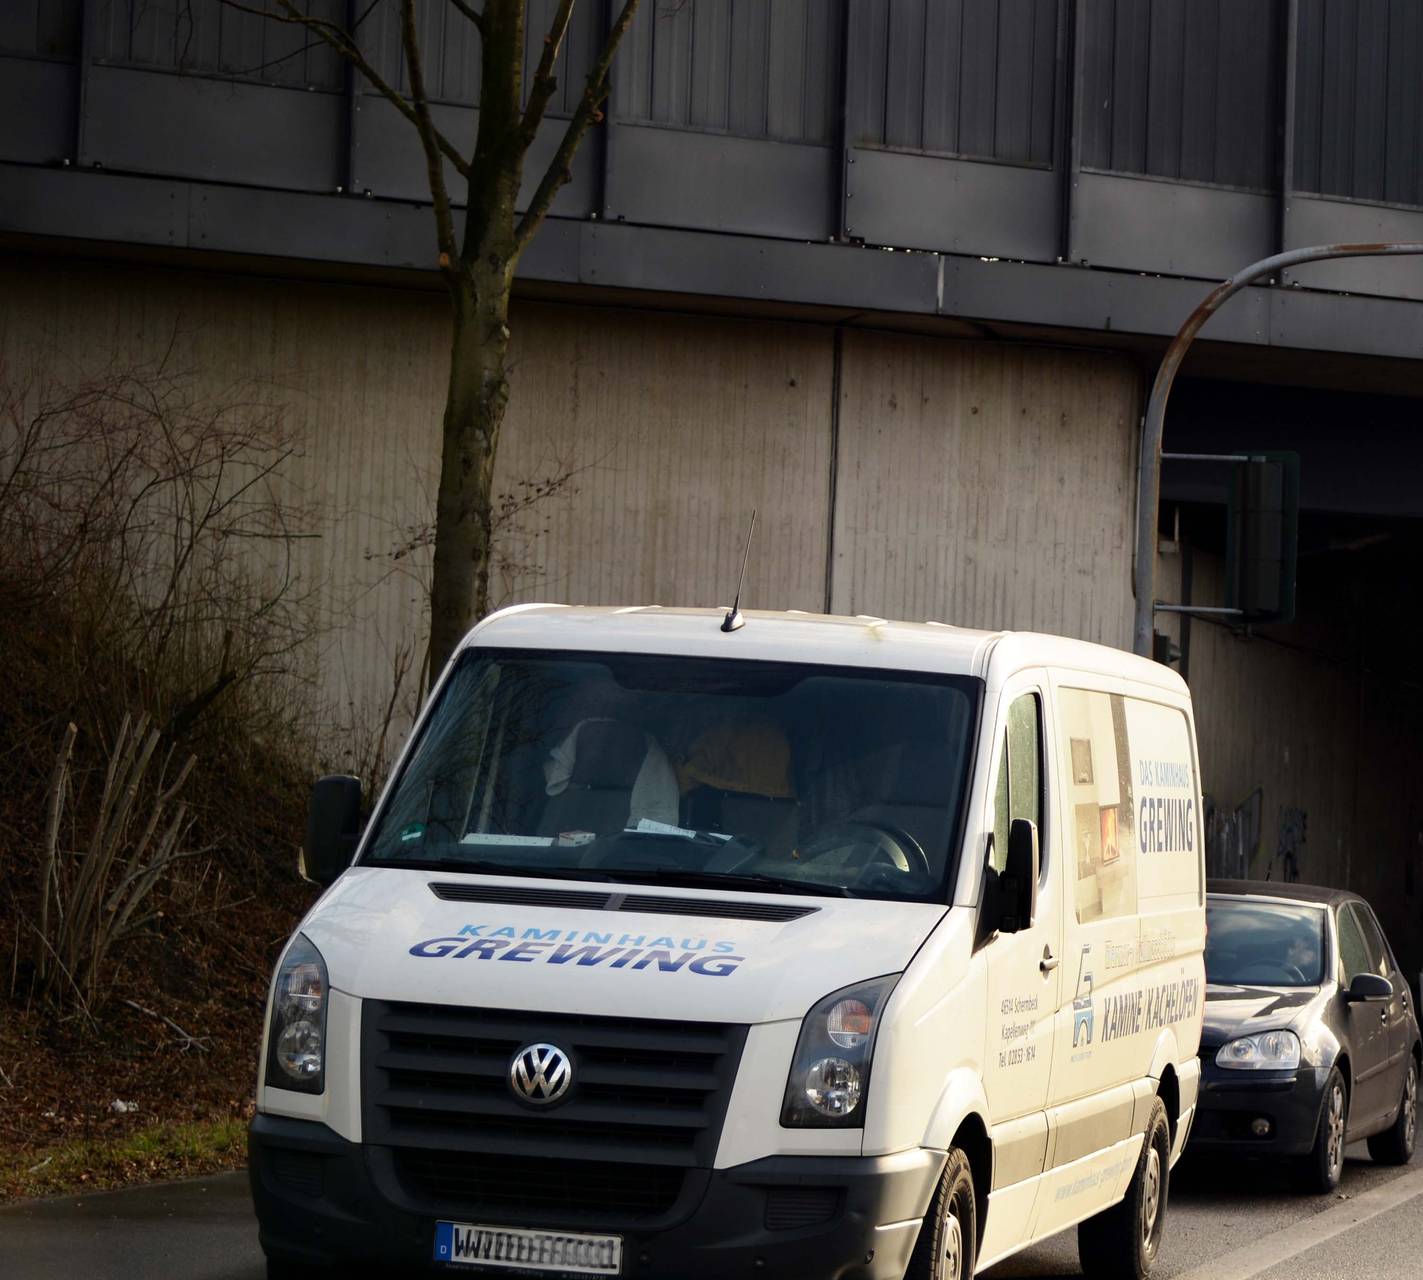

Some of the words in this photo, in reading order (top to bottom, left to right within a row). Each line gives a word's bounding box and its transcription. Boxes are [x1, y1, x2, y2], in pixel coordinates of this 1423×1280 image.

[1139, 760, 1153, 787] DAS
[1155, 761, 1189, 789] KAMINHAUS
[1140, 796, 1193, 854] GREWING
[457, 924, 737, 953] KAMINHAUS
[409, 937, 746, 977] GREWING
[1101, 990, 1143, 1043] KAMINE
[1145, 967, 1199, 1031] KACHELÖFEN
[440, 1245, 447, 1254] D
